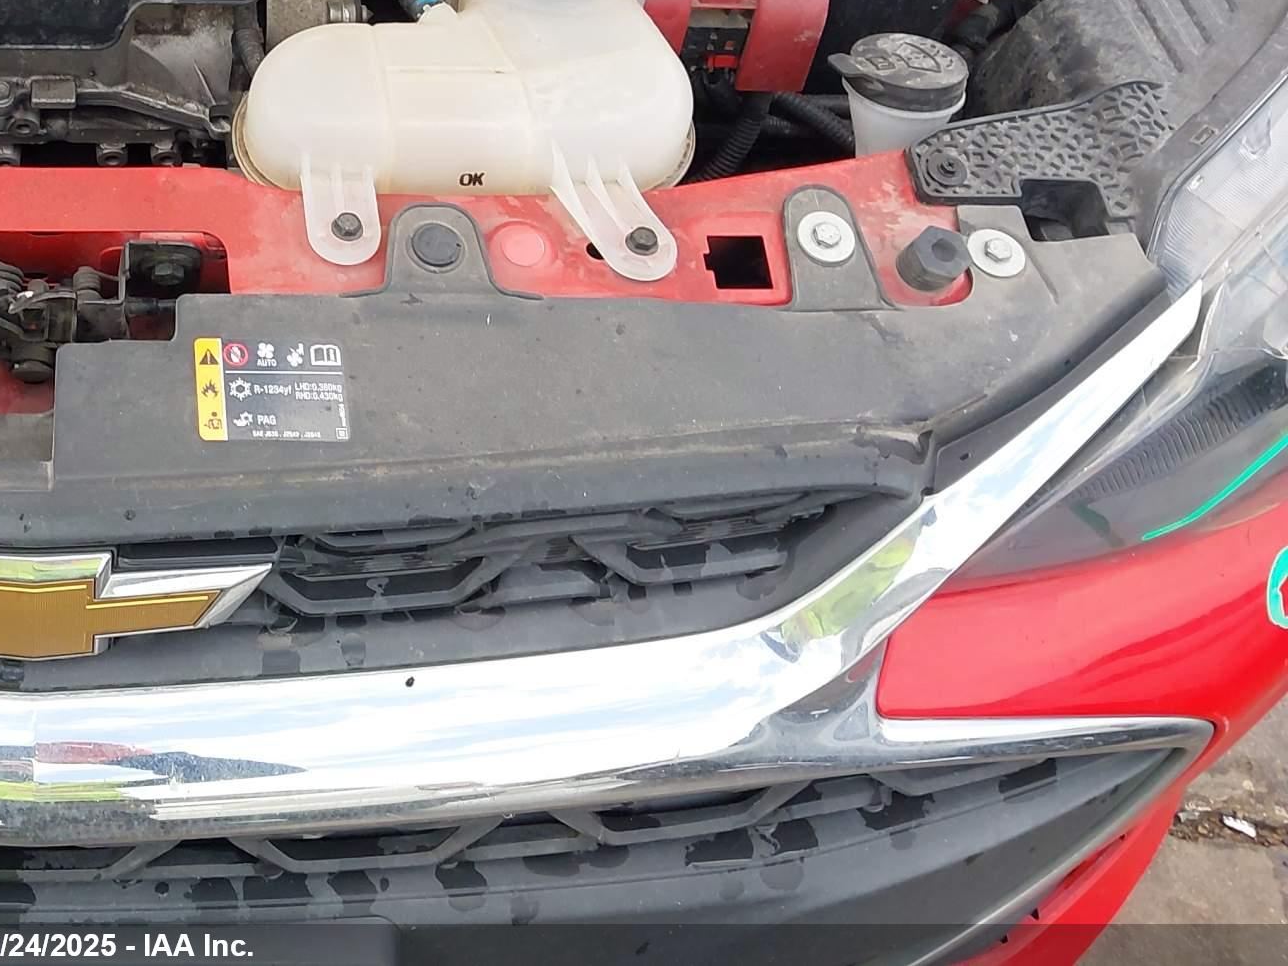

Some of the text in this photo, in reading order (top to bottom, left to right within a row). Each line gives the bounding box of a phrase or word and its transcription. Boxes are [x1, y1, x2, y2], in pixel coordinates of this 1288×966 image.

[459, 172, 485, 186] OK
[256, 359, 277, 367] AUTO
[253, 384, 292, 396] R-1234yf
[256, 414, 277, 425] PAG
